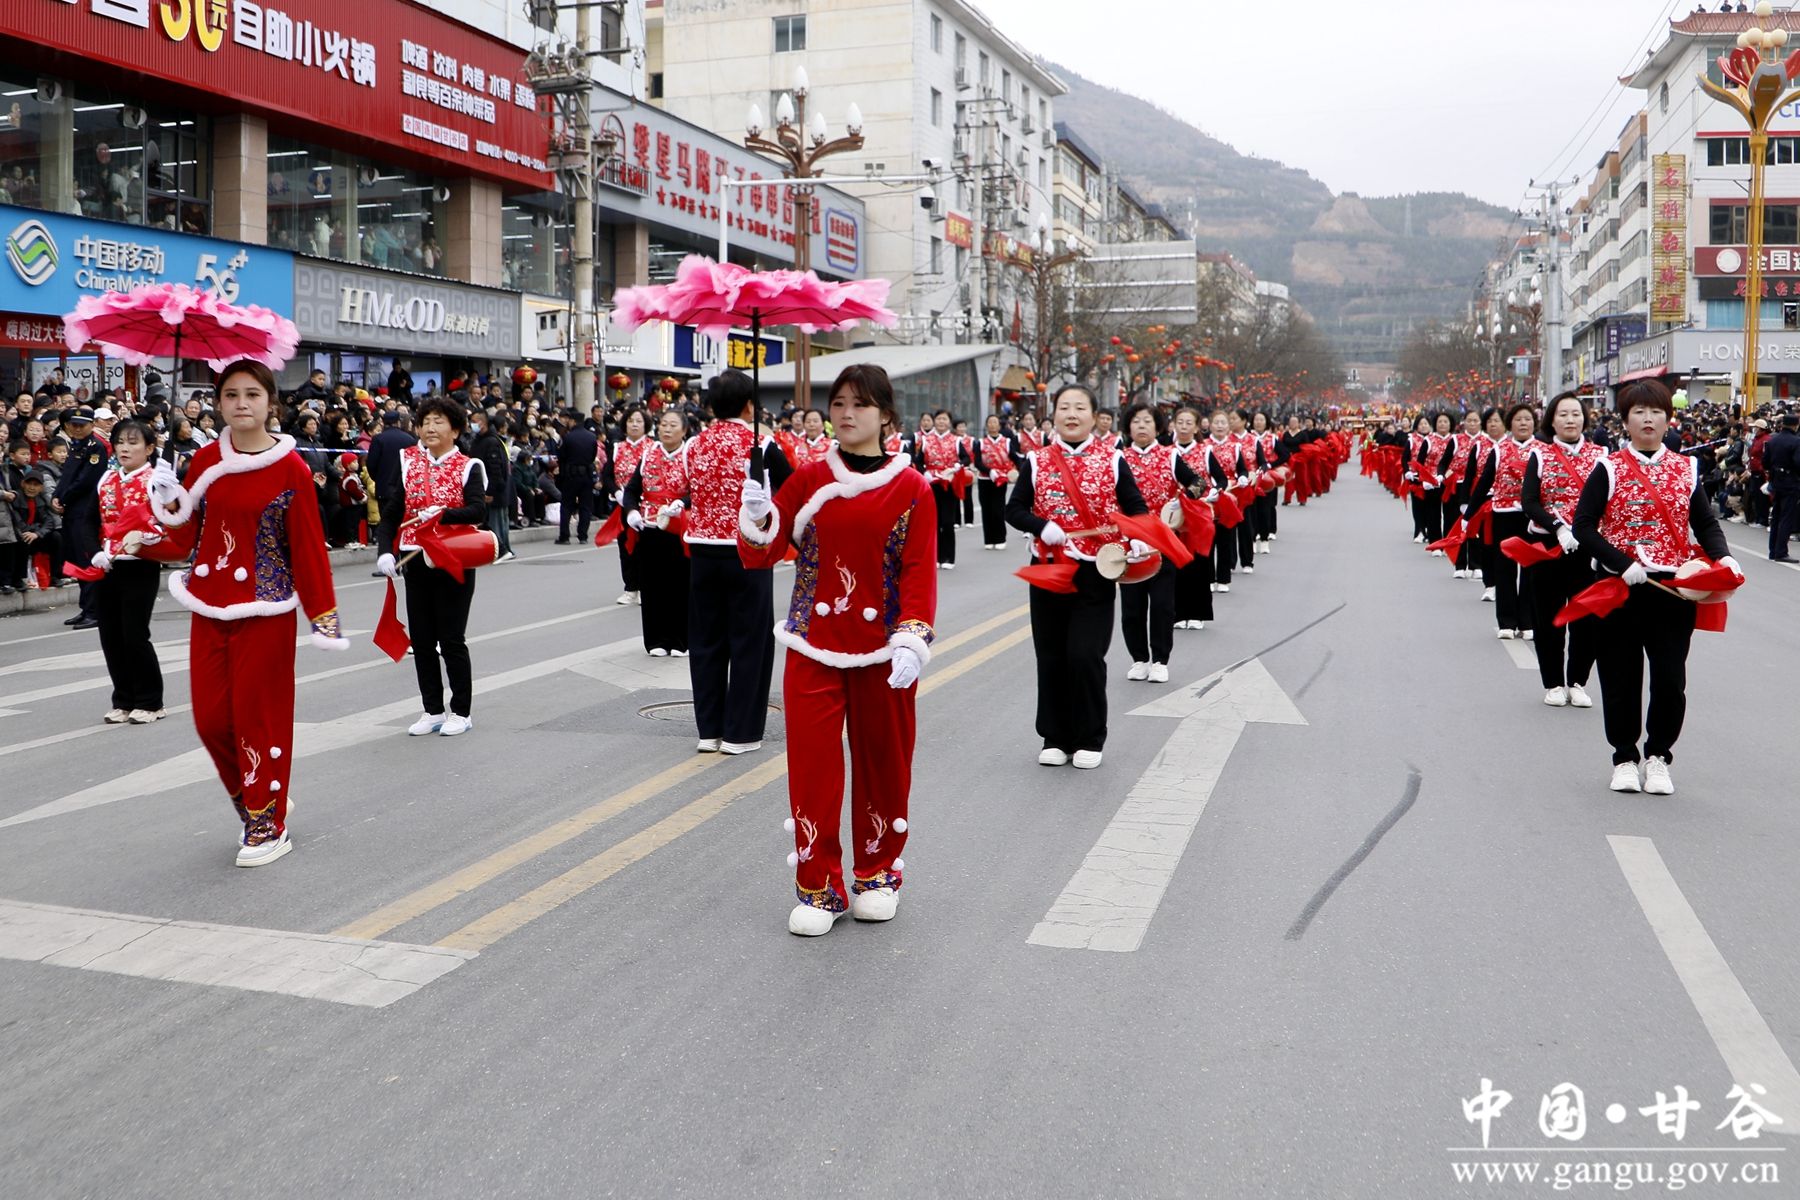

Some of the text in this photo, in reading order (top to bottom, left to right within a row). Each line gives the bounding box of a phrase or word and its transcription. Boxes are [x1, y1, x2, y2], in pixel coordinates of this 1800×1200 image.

[433, 50, 457, 82] 饮料
[489, 74, 511, 102] 水果
[74, 235, 165, 275] 中国移动
[338, 286, 445, 332] HM&OD
[693, 331, 719, 363] HLA
[67, 366, 92, 378] ivo
